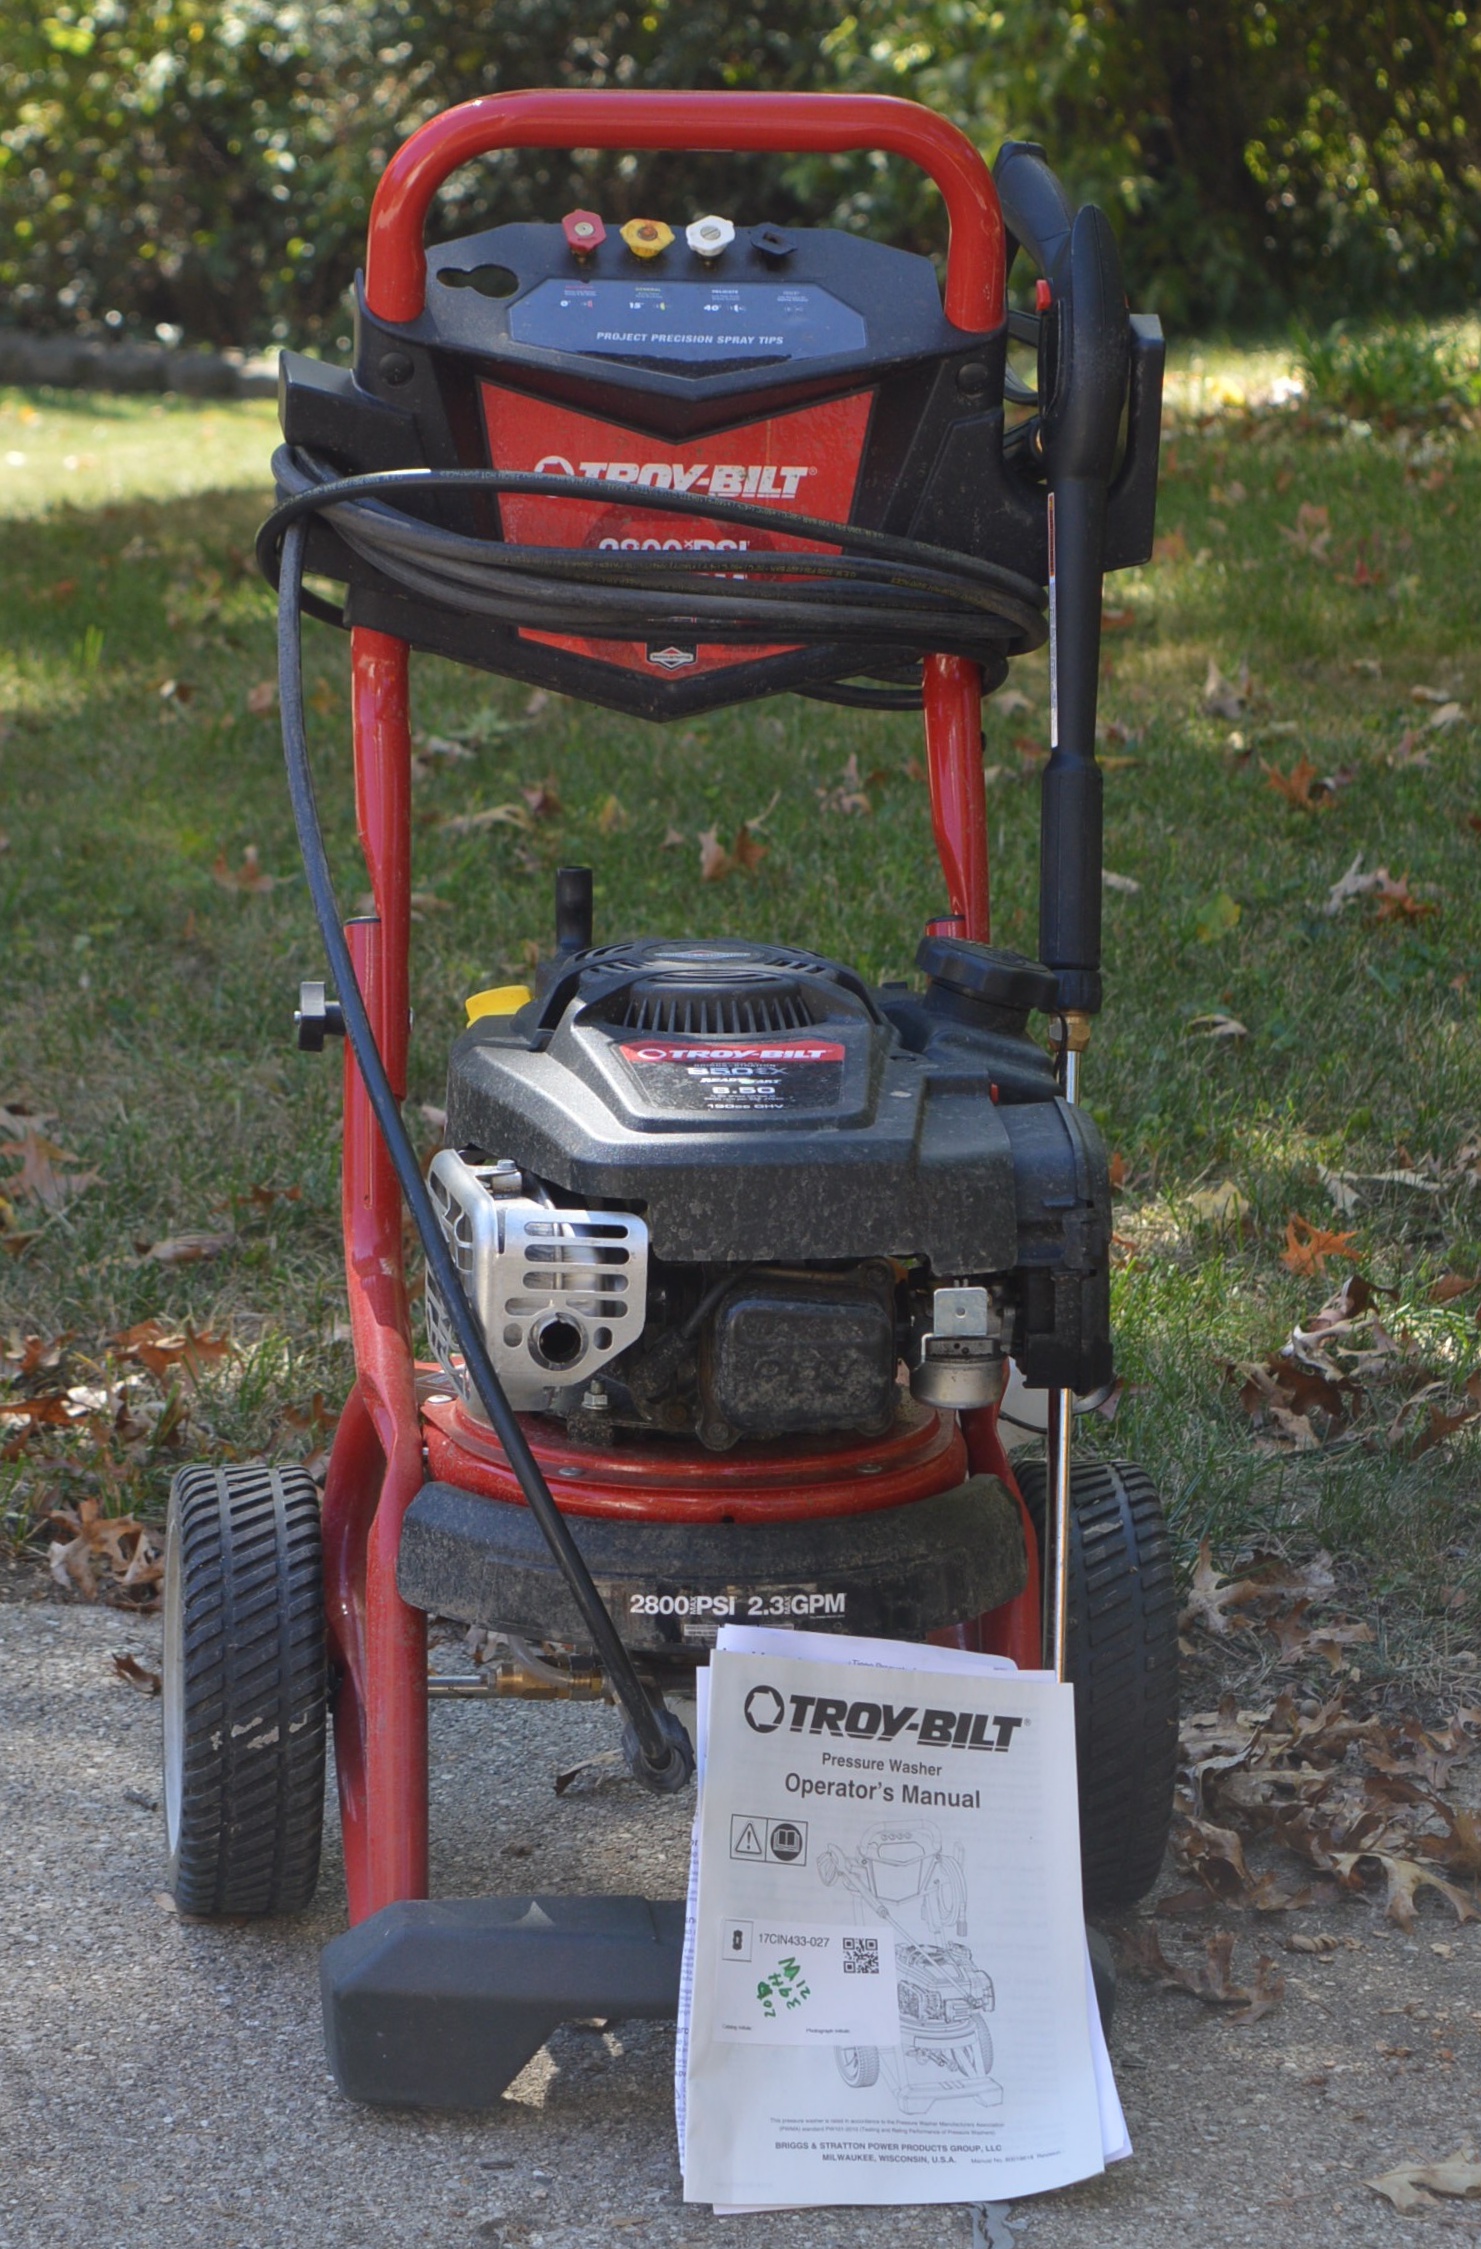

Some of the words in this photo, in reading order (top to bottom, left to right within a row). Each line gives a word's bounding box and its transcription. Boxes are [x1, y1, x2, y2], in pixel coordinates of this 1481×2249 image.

[596, 331, 648, 342] PROJECT
[651, 333, 713, 344] PRECISION
[716, 335, 755, 345] SPRAY
[759, 336, 785, 345] TIPS
[669, 1049, 827, 1060] TROY-BILT
[630, 1594, 689, 1616] 2800
[697, 1595, 736, 1616] PSI
[747, 1595, 785, 1616] 2.3
[791, 1592, 847, 1615] GPM
[788, 1694, 1023, 1752] TROY-BILT
[821, 1751, 885, 1772] Pressure
[888, 1757, 943, 1777] Washer
[784, 1771, 895, 1802] Operator's
[901, 1783, 981, 1809] Manual
[758, 1932, 831, 1948] 17CIN433-027
[774, 2141, 809, 2151] BRIGGS
[811, 2142, 818, 2151] &
[819, 2142, 866, 2151] STRATTON
[867, 2143, 899, 2152] POWER
[901, 2143, 948, 2153] PRODUCTS
[949, 2144, 984, 2154] GROUP,
[985, 2144, 1003, 2152] LLC
[822, 2153, 878, 2163] MILWAUKEE,
[878, 2154, 930, 2165] WISCONSIN,
[931, 2156, 957, 2164] U.S.A.
